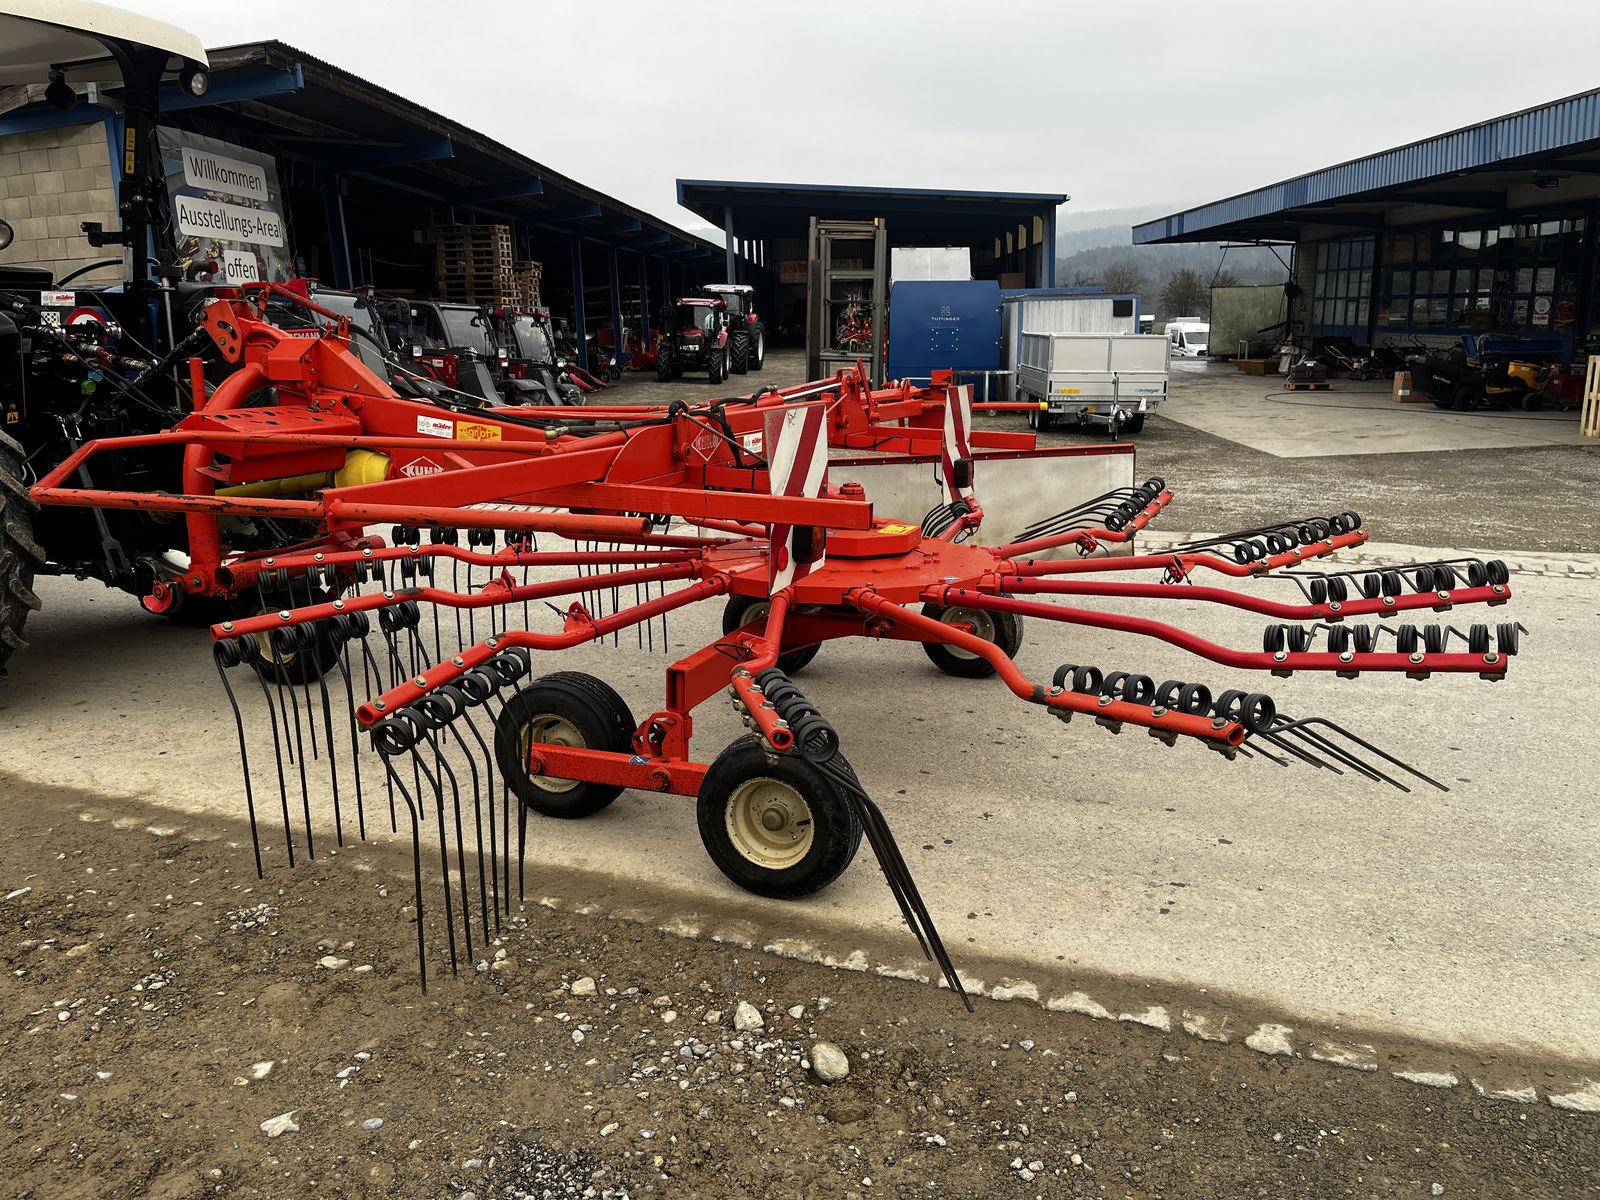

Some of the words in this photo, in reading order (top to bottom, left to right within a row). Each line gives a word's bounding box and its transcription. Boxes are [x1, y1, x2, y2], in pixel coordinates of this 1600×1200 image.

[189, 156, 262, 191] Willkommen
[180, 204, 282, 238] Ausstellungs-Areal
[227, 258, 257, 281] offen
[432, 421, 452, 431] mäder
